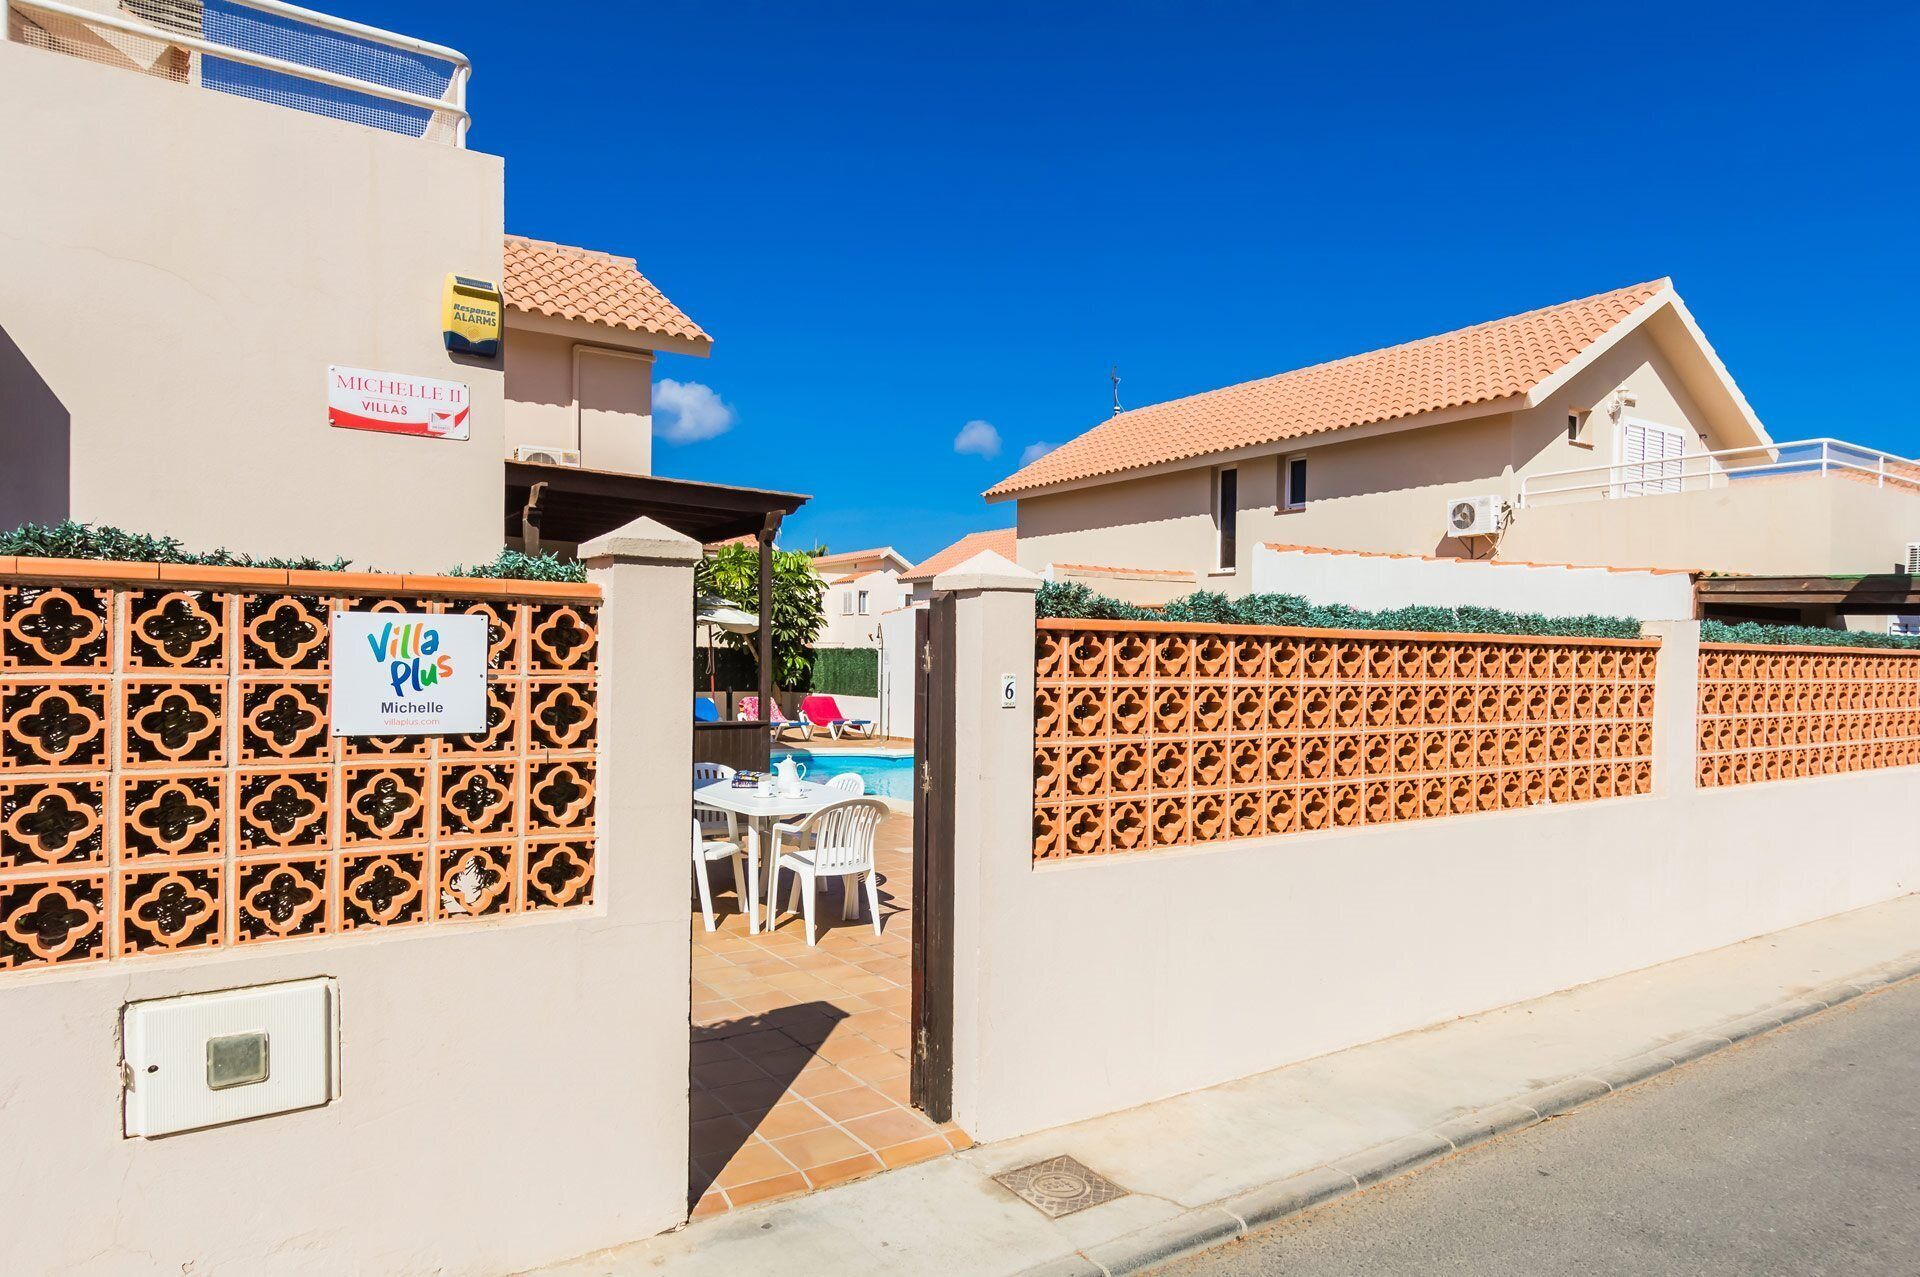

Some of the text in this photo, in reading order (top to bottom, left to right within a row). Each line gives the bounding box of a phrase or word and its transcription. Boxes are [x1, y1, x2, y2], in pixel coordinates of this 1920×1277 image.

[453, 303, 497, 317] Response
[453, 312, 497, 327] ALARMS
[337, 375, 461, 403] MICHELLE II
[361, 401, 408, 416] VILLAS
[367, 621, 440, 663] Villa
[390, 654, 454, 698] Plus
[1005, 681, 1015, 700] 6
[381, 702, 444, 714] Michelle
[384, 717, 440, 727] villaplus.com
